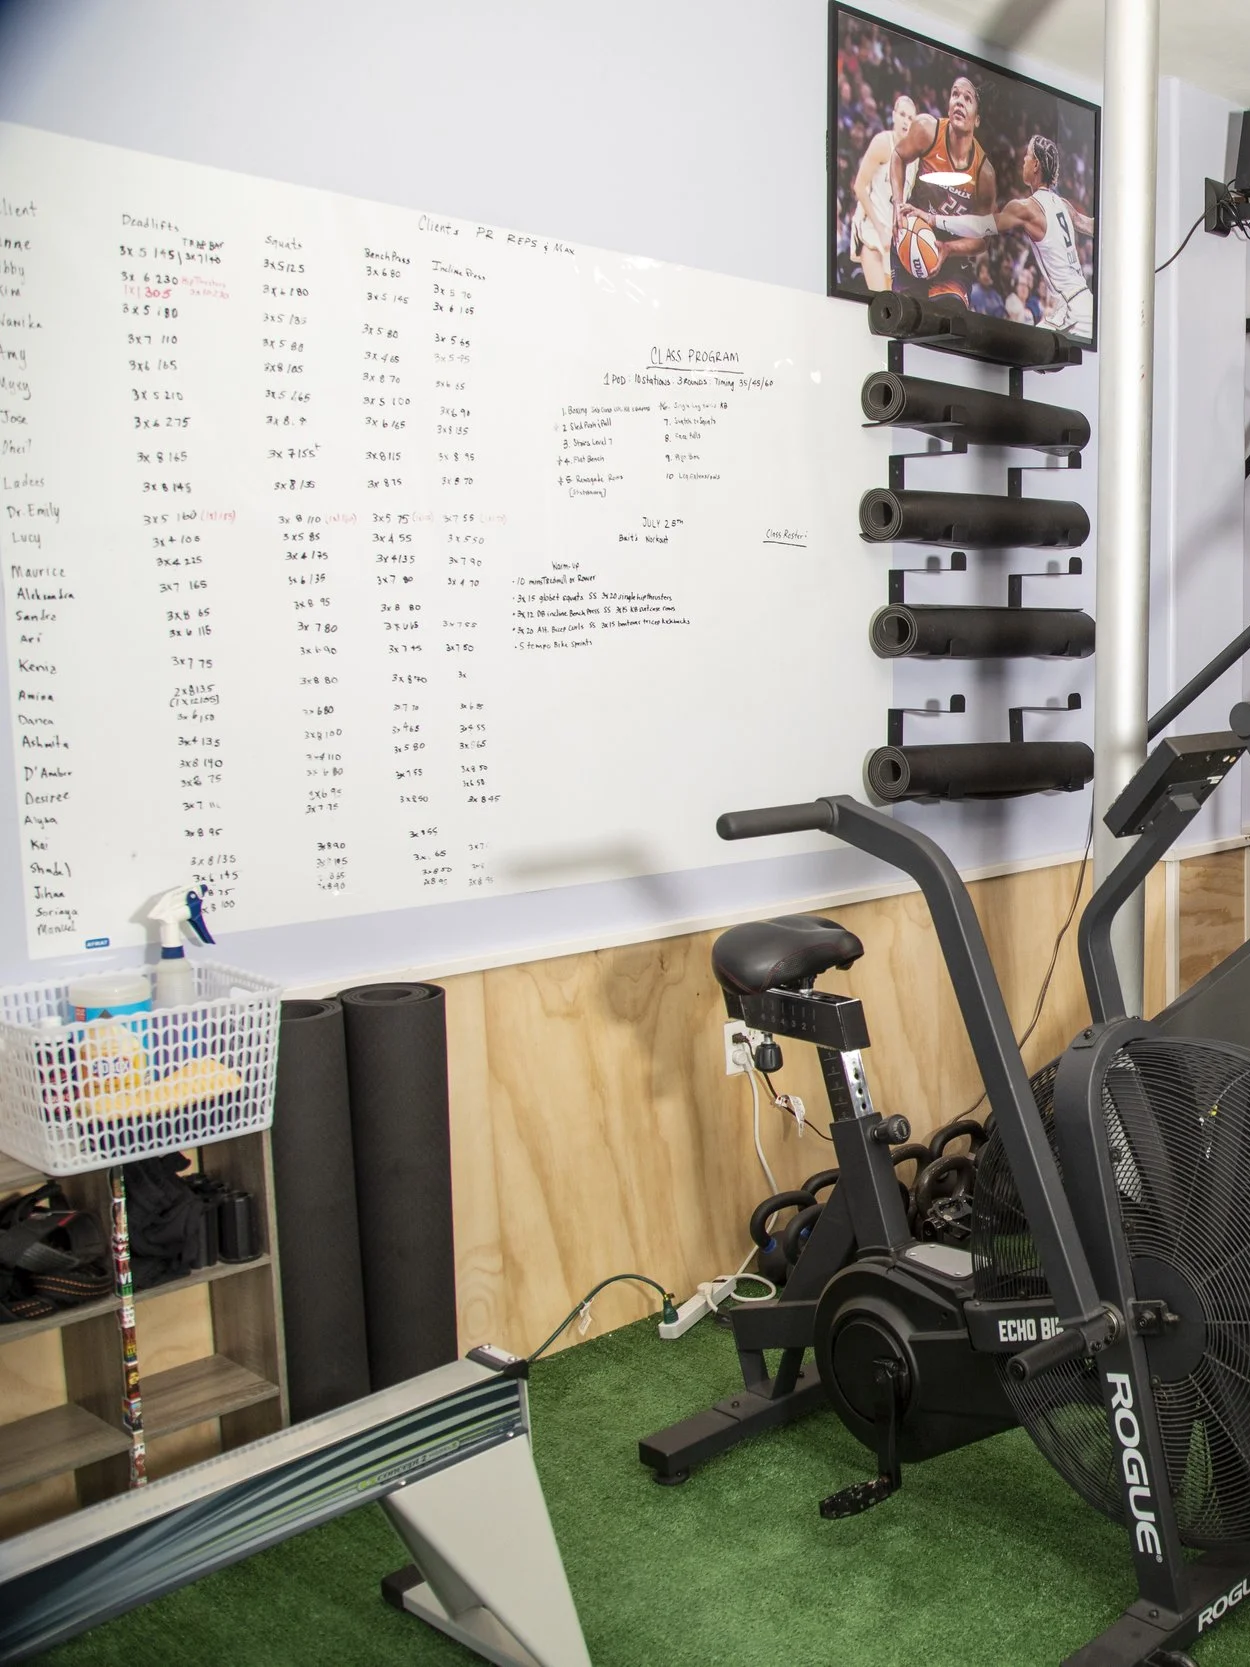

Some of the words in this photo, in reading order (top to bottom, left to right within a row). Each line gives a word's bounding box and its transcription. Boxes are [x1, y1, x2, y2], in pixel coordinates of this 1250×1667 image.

[651, 347, 681, 364] CLASS
[688, 349, 739, 363] PROGRAM
[766, 529, 781, 538] Class
[998, 1319, 1037, 1342] ECHO
[1040, 1317, 1064, 1340] BI
[1106, 1373, 1163, 1554] ROGUE
